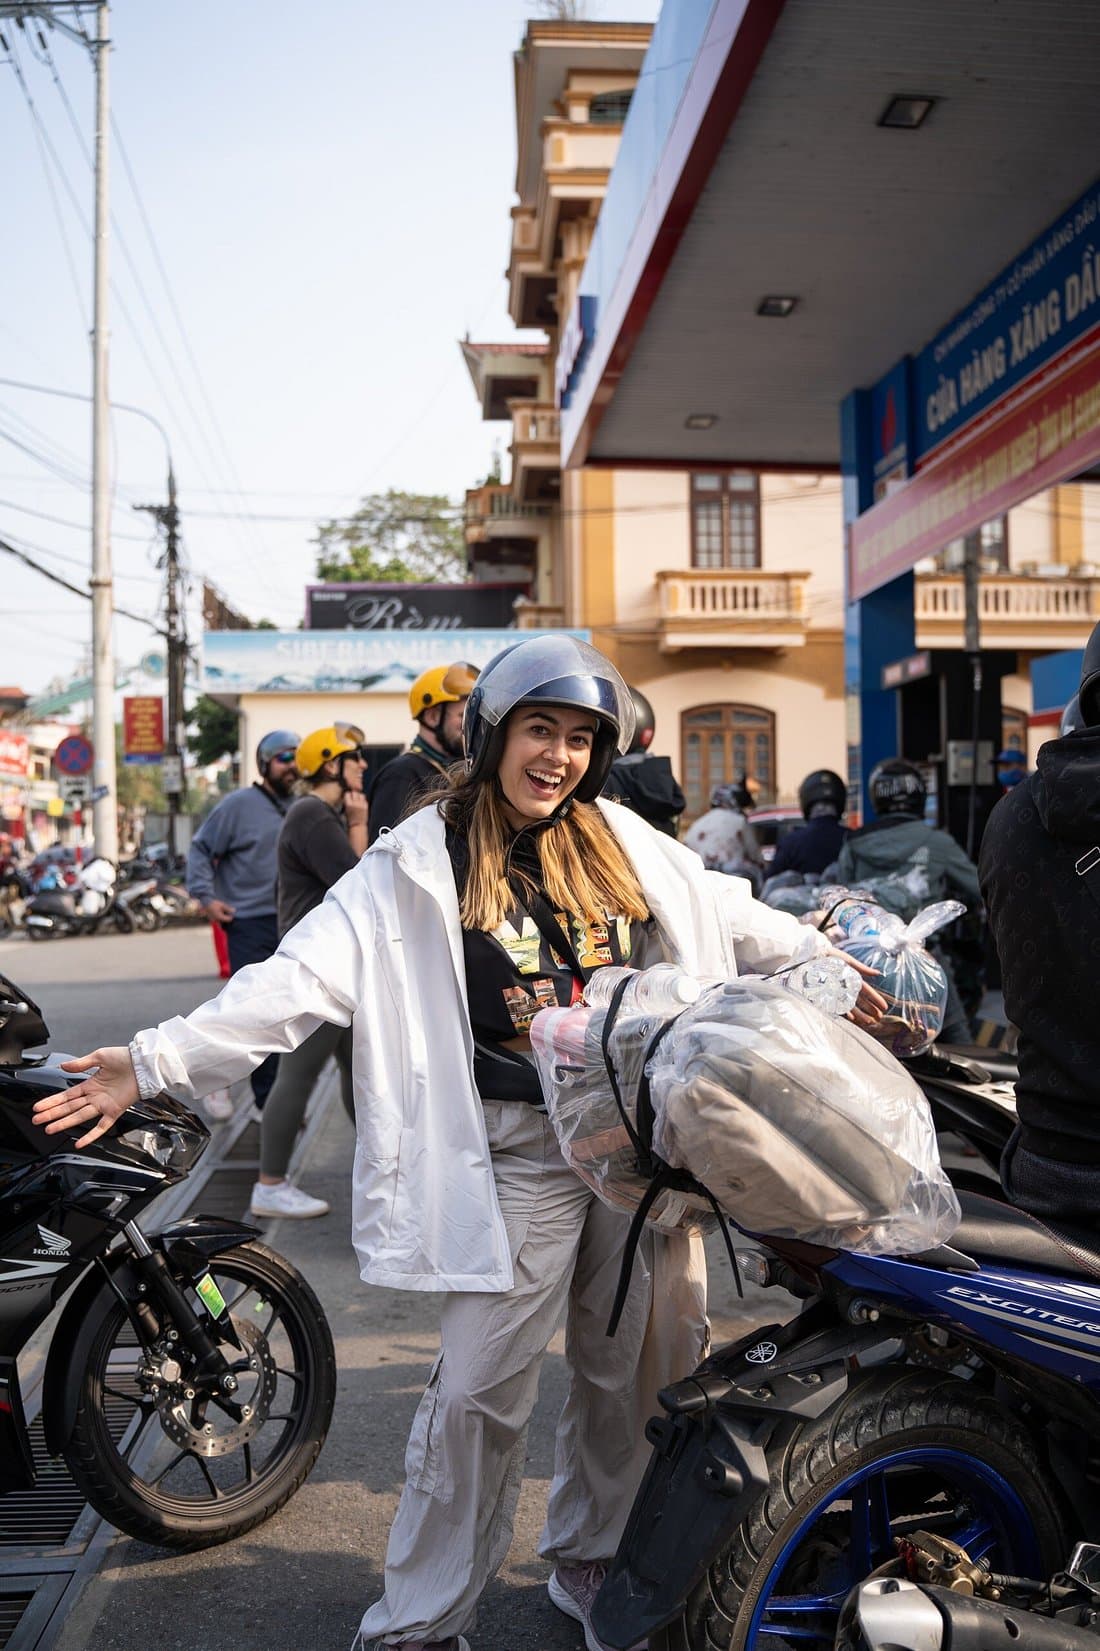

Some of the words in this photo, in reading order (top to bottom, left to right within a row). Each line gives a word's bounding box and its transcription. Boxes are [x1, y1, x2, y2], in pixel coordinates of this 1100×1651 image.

[959, 337, 1006, 406] HÀNG
[1009, 290, 1061, 368] XĂNG
[32, 1248, 71, 1257] HONDA
